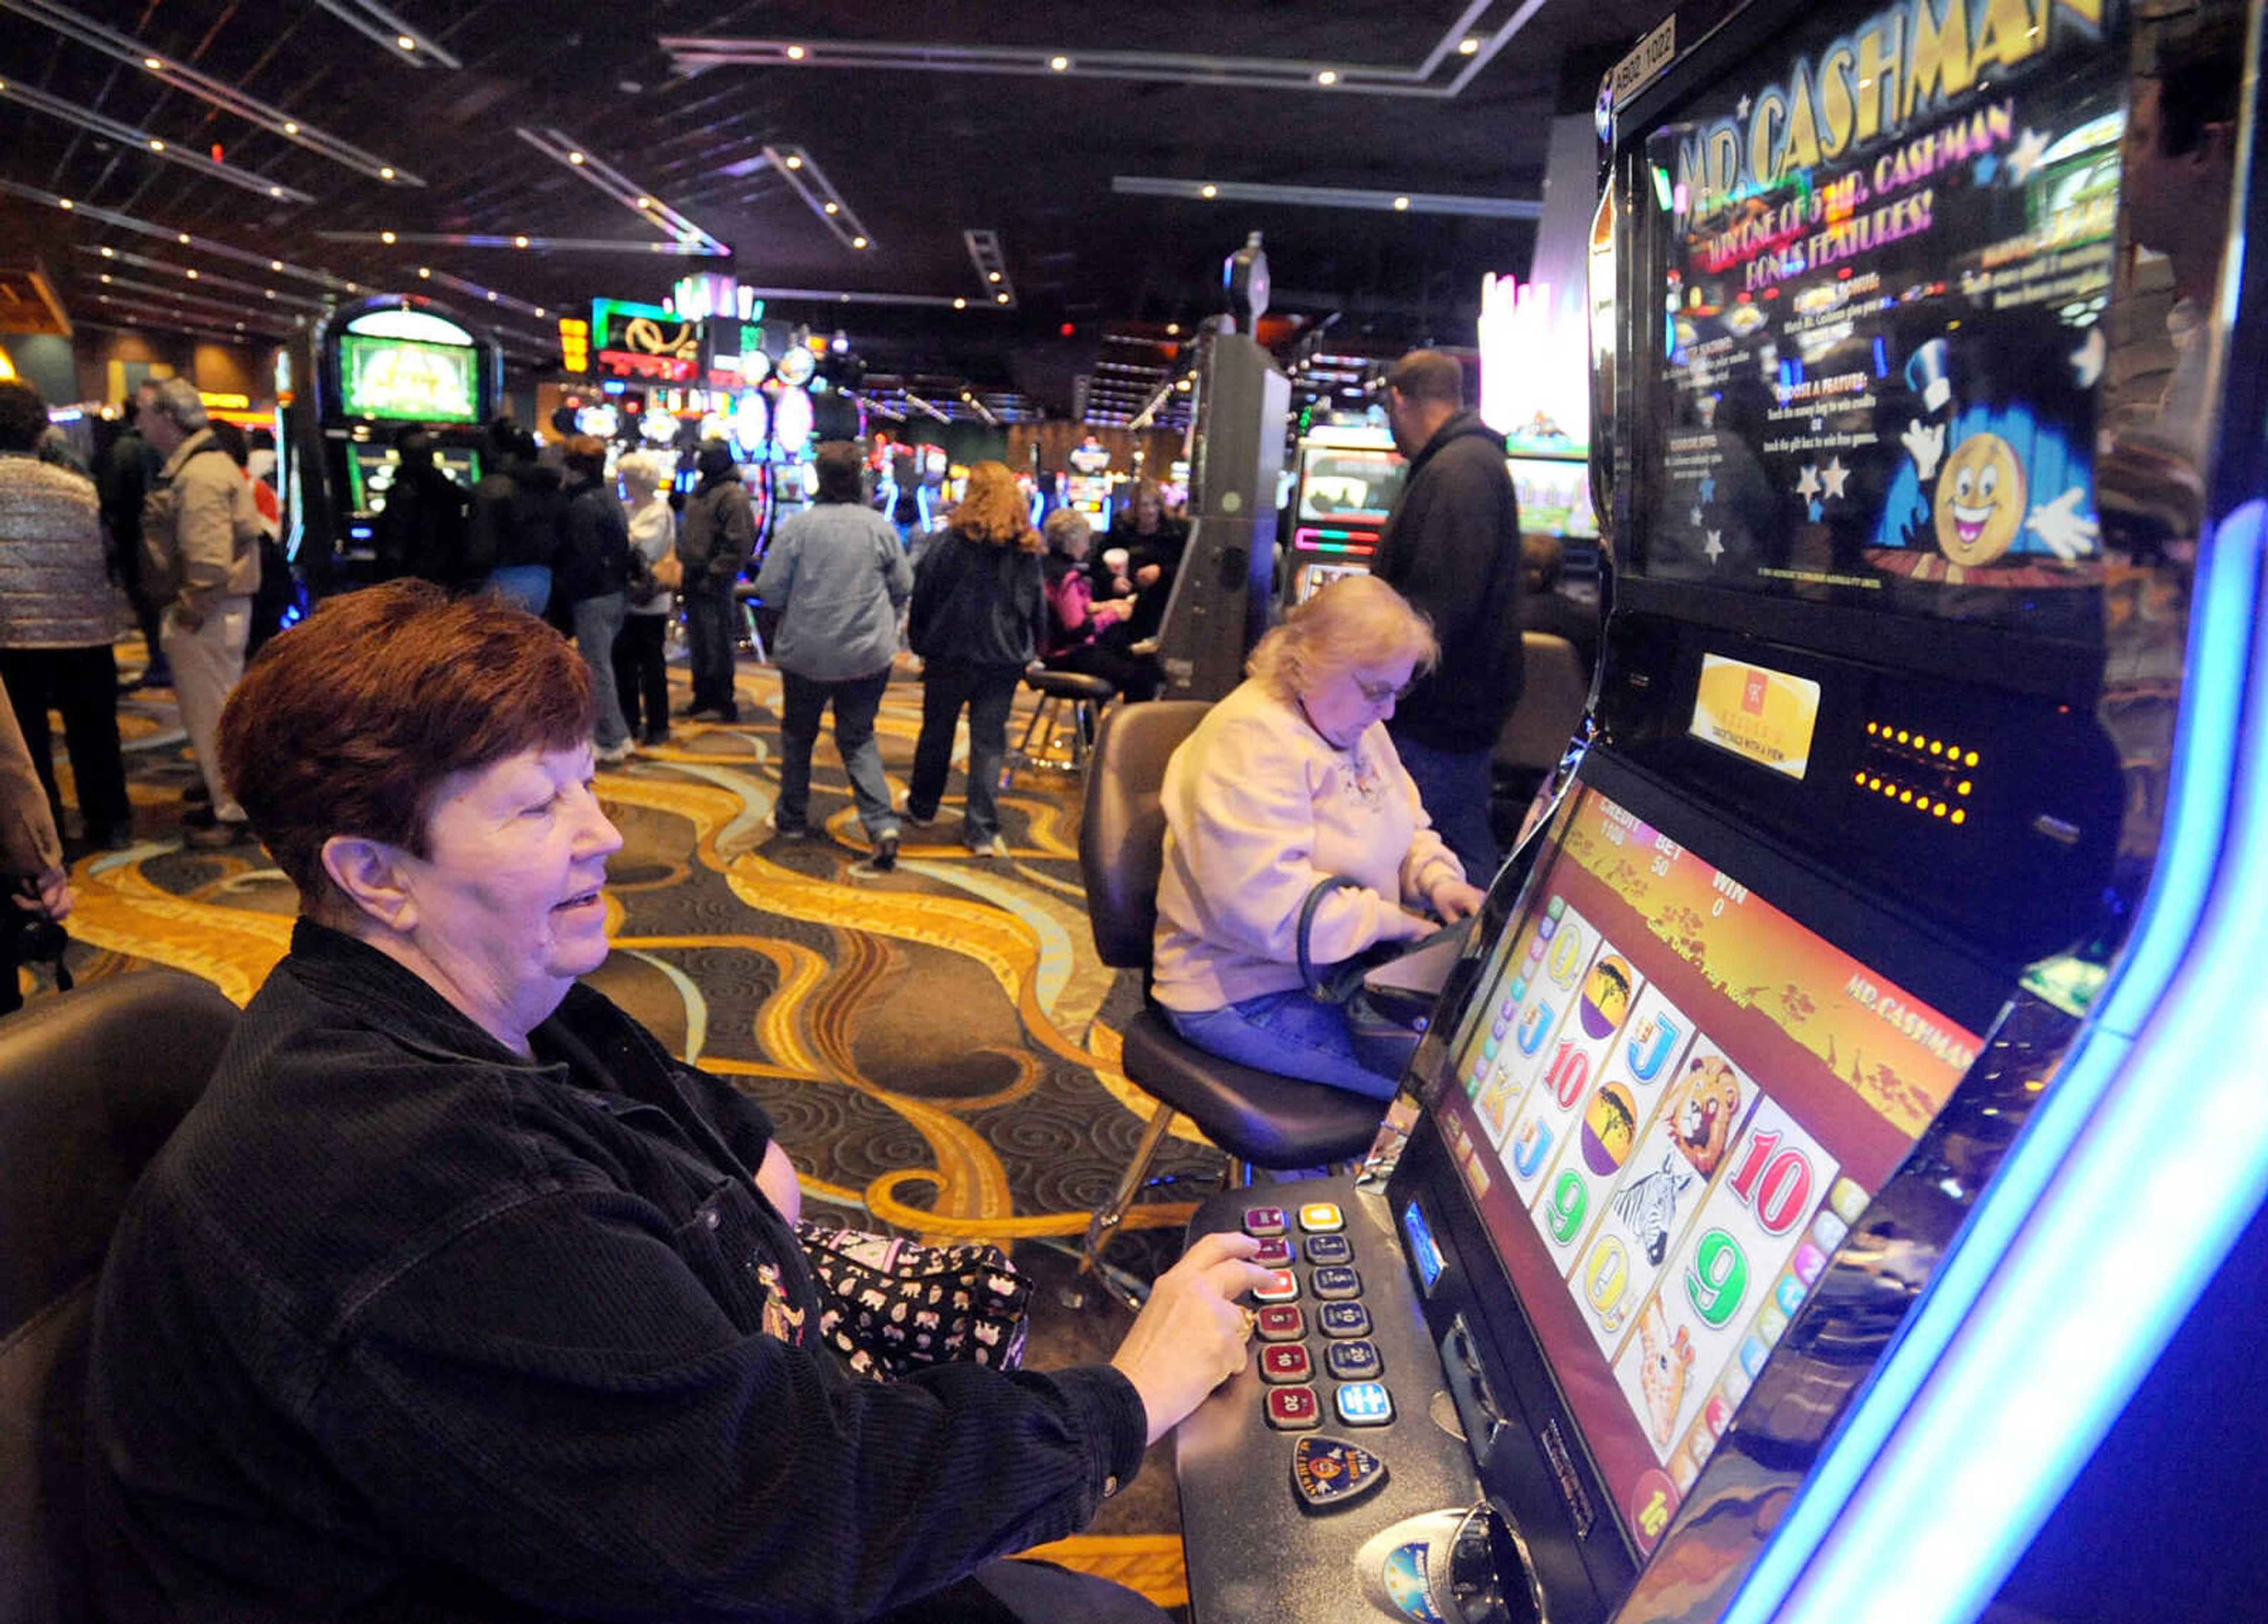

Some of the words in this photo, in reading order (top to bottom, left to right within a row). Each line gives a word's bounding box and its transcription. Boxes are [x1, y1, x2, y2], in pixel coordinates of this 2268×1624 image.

[1646, 27, 1671, 69] 1022
[1780, 197, 1804, 236] OF
[1808, 187, 1822, 223] 5
[1873, 97, 2015, 194] CASHMAN
[1813, 380, 1821, 397] A
[1599, 797, 1643, 833] CREDIT
[1656, 832, 1685, 860] BET
[1651, 856, 1668, 877] 50
[1713, 869, 1748, 905] WIN
[1712, 896, 1725, 917] 0
[1517, 999, 1556, 1057] J
[1628, 1014, 1680, 1082] J
[1543, 1042, 1591, 1110] 10
[1482, 1084, 1521, 1133] K
[1513, 1118, 1555, 1180] J
[1730, 1129, 1814, 1234] 10
[1546, 1169, 1589, 1240] 9
[1685, 1228, 1749, 1328] 9
[1271, 1314, 1285, 1323] 5
[1342, 1308, 1356, 1323] 10
[1277, 1353, 1292, 1367] 10
[1350, 1347, 1367, 1362] 20
[1283, 1395, 1300, 1413] 20
